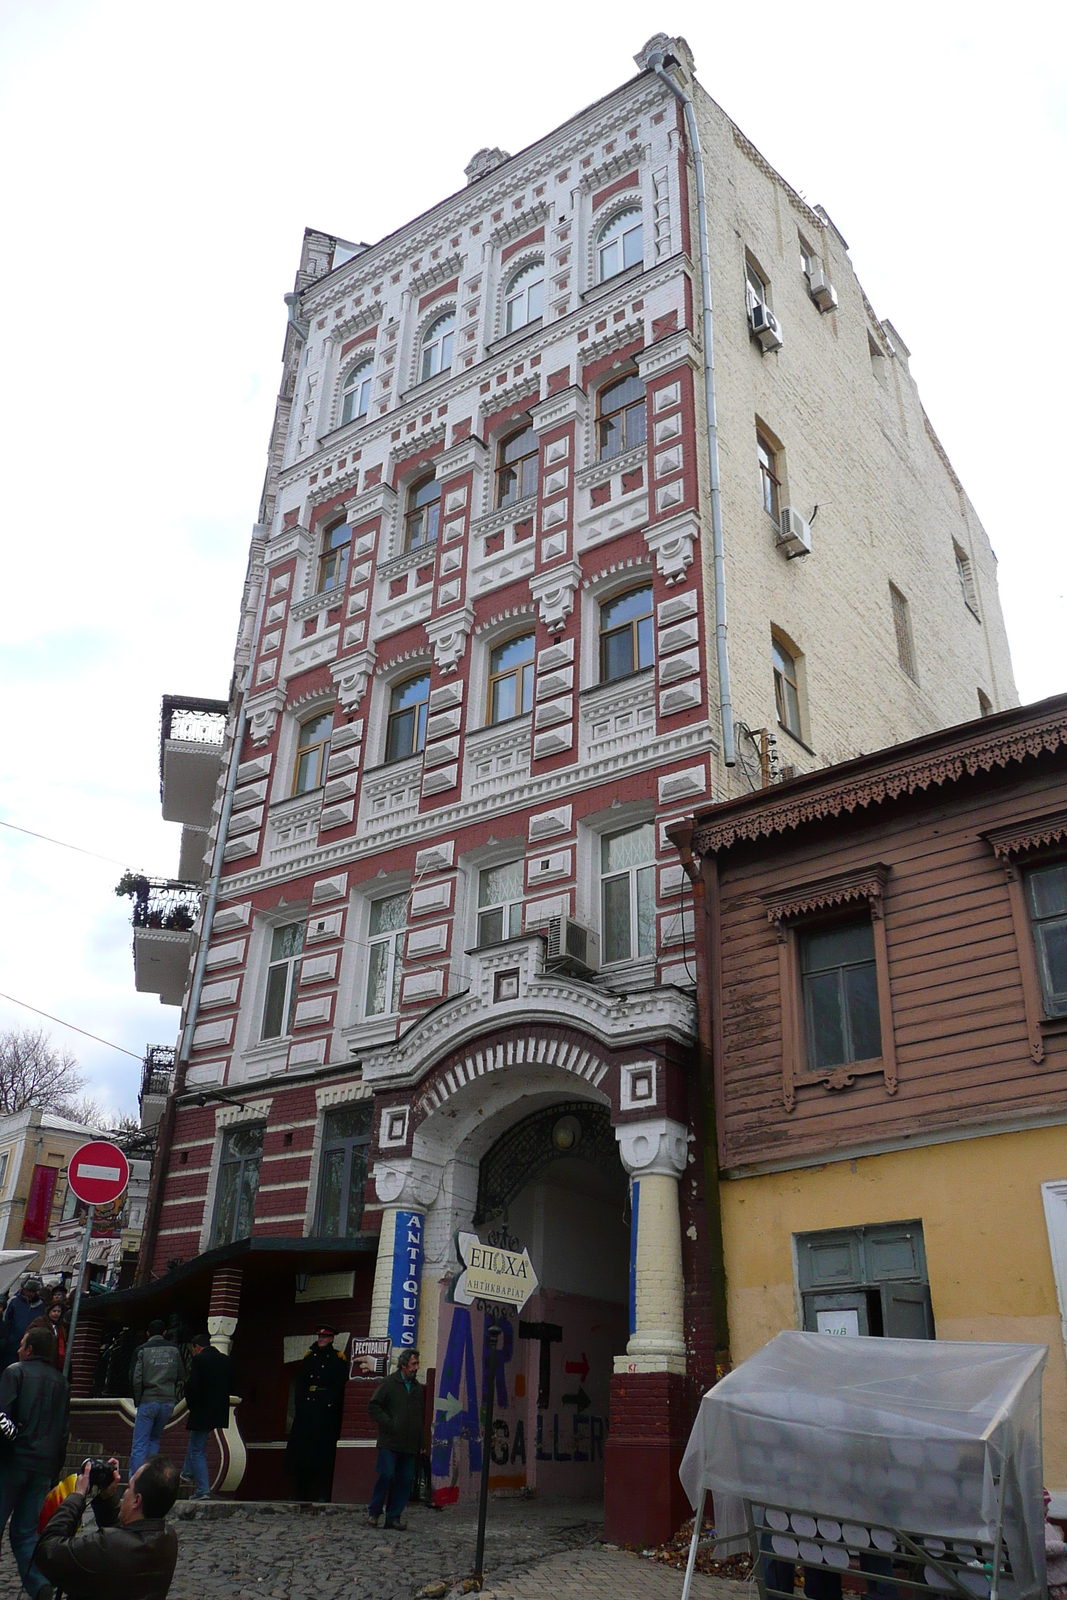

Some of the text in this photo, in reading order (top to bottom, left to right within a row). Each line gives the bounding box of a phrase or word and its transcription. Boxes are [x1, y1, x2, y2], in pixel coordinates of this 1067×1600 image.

[400, 1214, 422, 1345] ANTIQUES
[467, 1279, 525, 1299] АНТИКВАРІАТ
[431, 1307, 563, 1477] ART
[491, 1413, 610, 1465] GALLER
